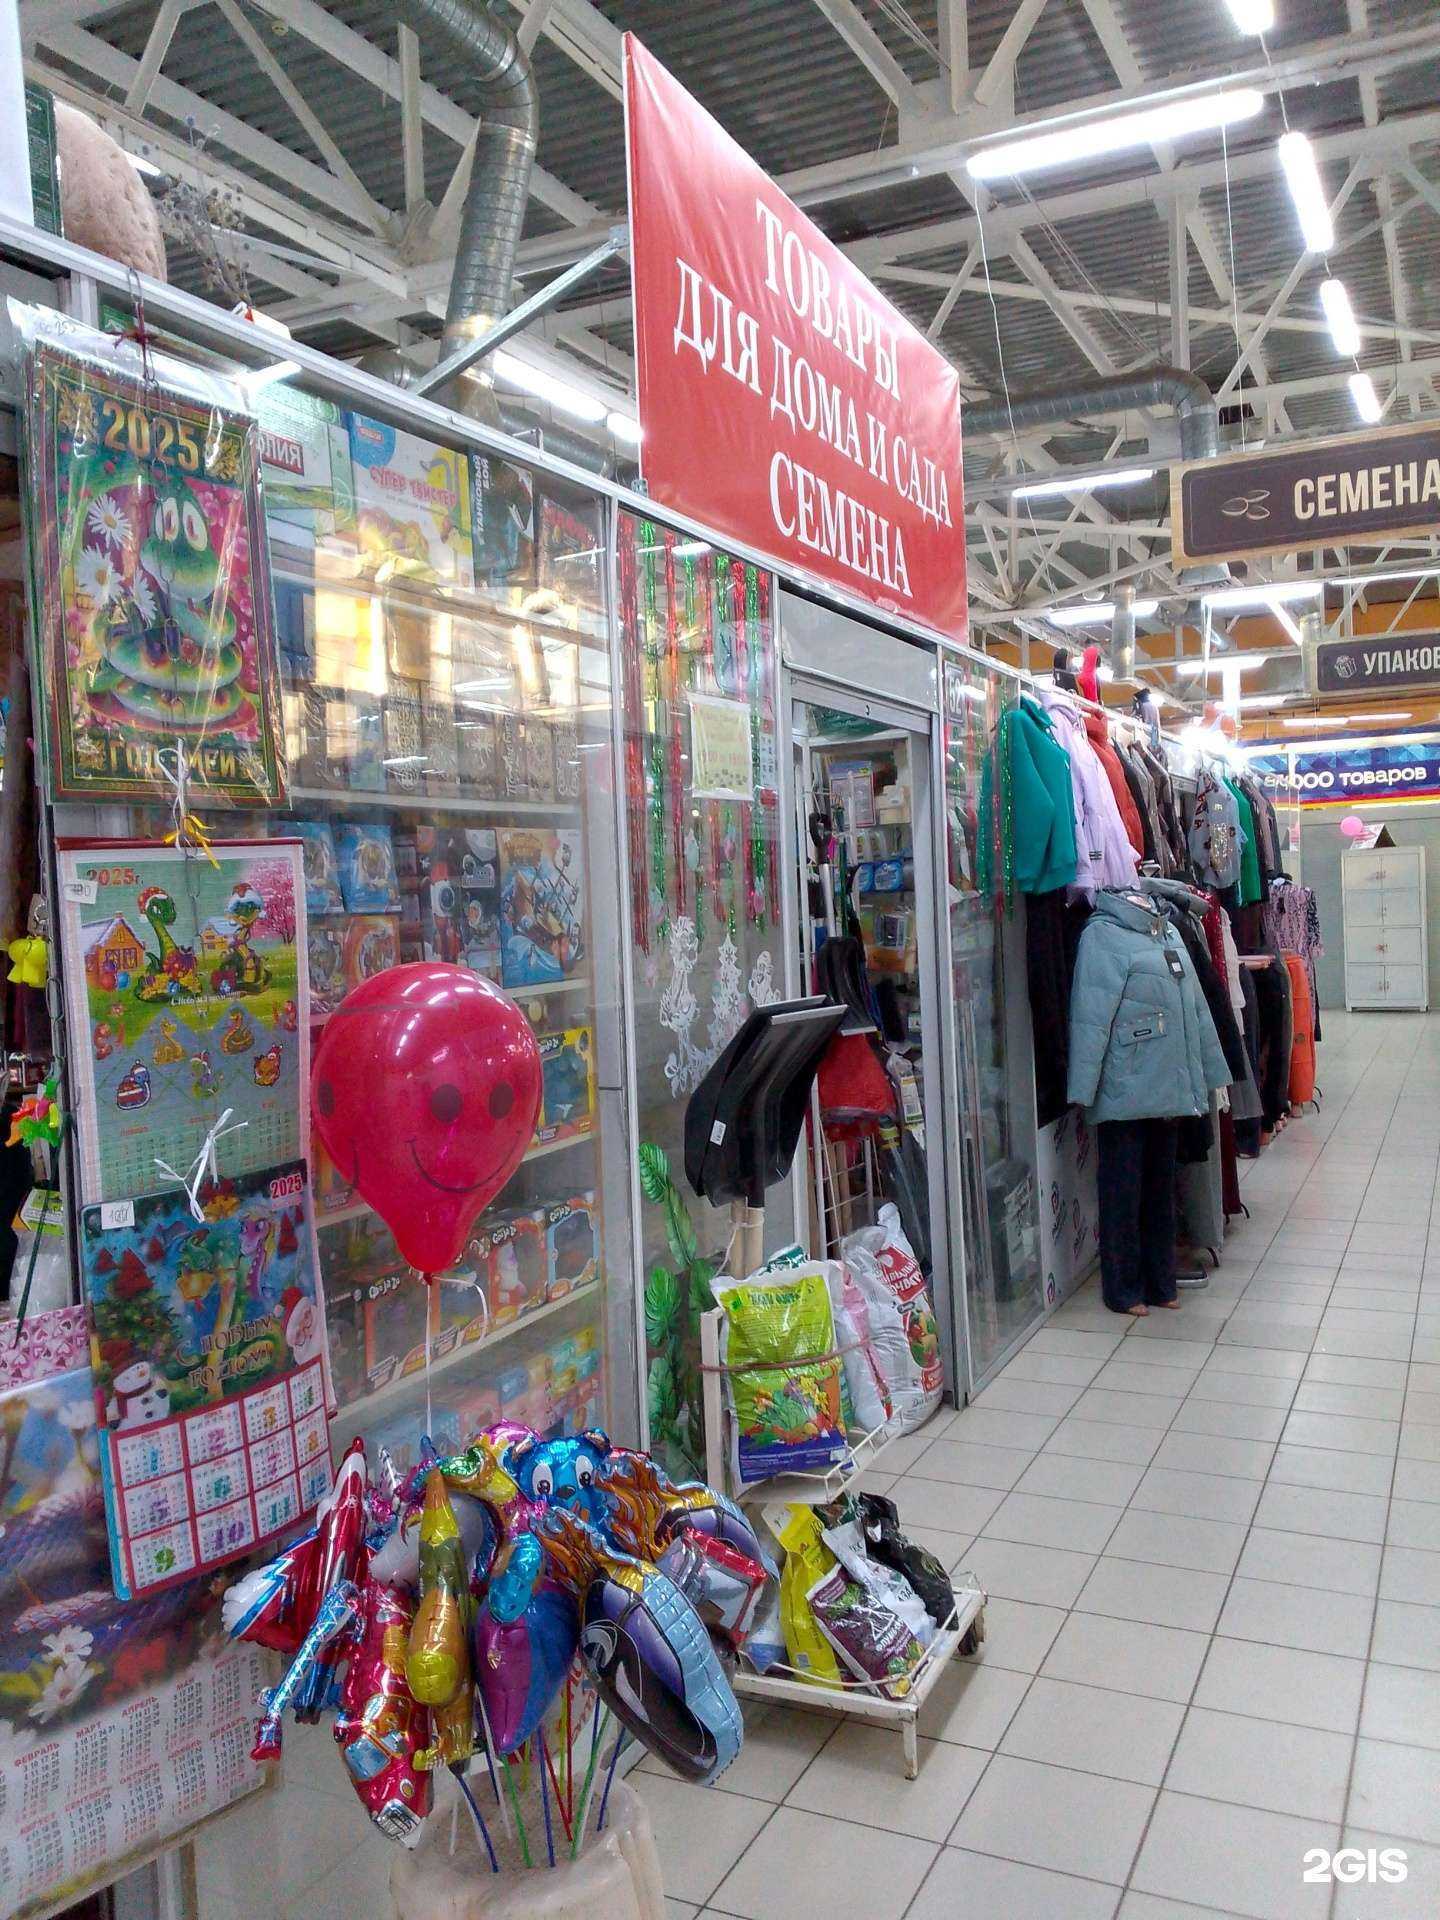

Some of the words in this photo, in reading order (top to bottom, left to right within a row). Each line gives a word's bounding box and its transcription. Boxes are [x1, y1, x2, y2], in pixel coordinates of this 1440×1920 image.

[755, 199, 901, 400] ТОВАРЫ
[673, 257, 763, 397] ДЛЯ
[770, 334, 863, 468] ДОМА
[866, 412, 889, 485] И
[893, 435, 953, 532] САДА
[103, 400, 199, 471] 2025
[1294, 458, 1440, 520] СЕМЕНА
[769, 450, 913, 599] СЕМЕНА
[1339, 766, 1427, 786] товаров
[270, 1174, 303, 1200] 2025
[75, 1721, 102, 1739] МАРТ
